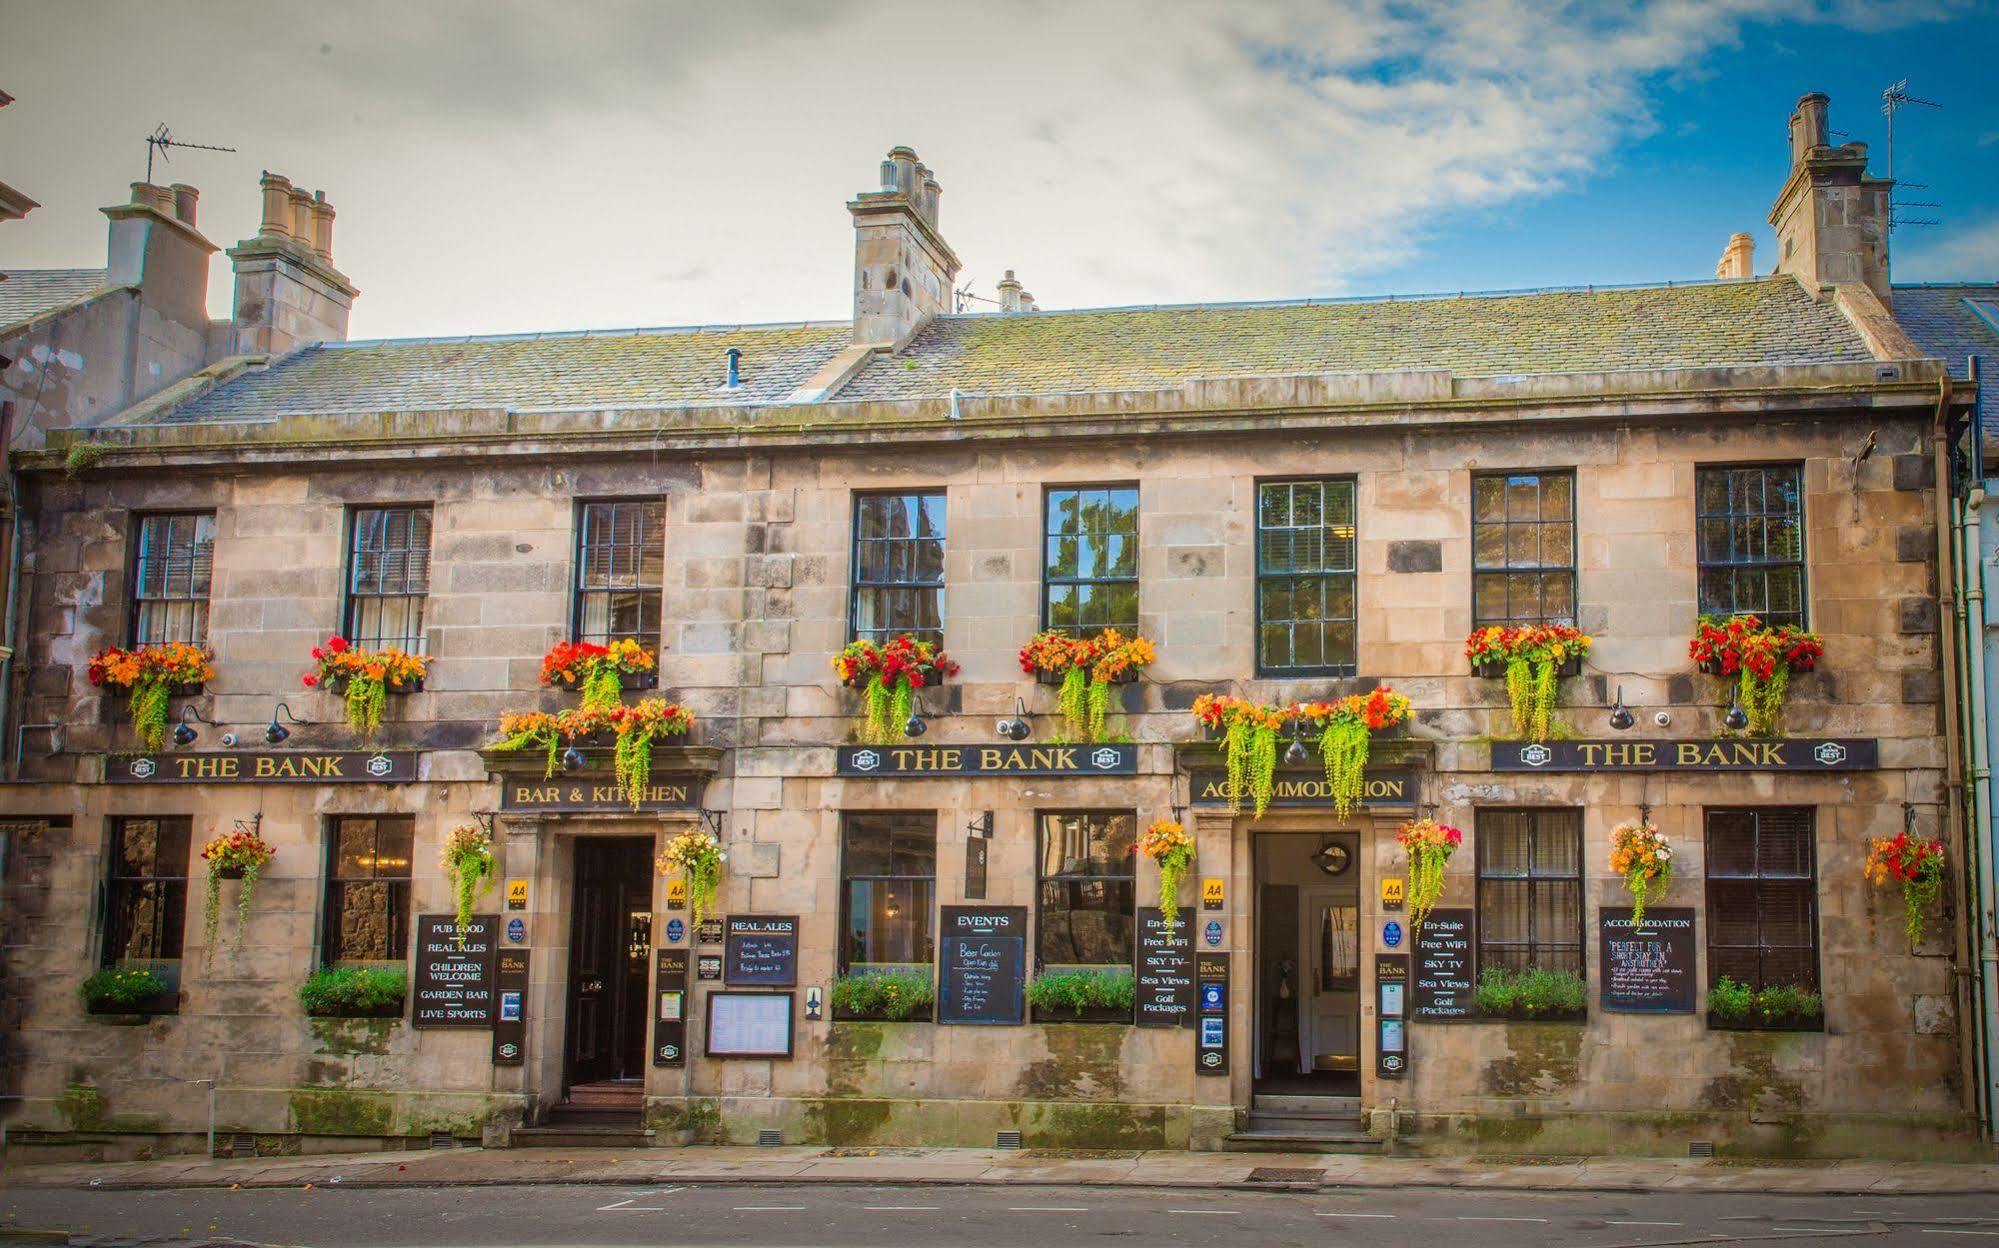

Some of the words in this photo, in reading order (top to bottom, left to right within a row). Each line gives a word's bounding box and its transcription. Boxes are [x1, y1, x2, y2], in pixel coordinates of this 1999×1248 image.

[891, 749, 962, 770] THE
[980, 748, 1078, 770] BANK
[1577, 744, 1657, 766] THE
[1676, 743, 1786, 765] BANK
[176, 757, 240, 777] THE
[255, 756, 343, 777] BANK
[1201, 780, 1403, 798] ACCMMODION
[515, 787, 561, 803] BAR
[569, 787, 584, 803] &
[512, 886, 525, 896] AA
[1207, 885, 1221, 895] AA
[1385, 885, 1400, 896] AA
[958, 916, 1009, 926] EVENTS
[1147, 919, 1185, 928] En-Site
[1423, 921, 1464, 930] En-Suite
[1604, 919, 1690, 928] ACCOMMODATION
[433, 924, 453, 933] PUB
[731, 922, 760, 931] REAL
[764, 922, 792, 931] ALES
[1144, 938, 1164, 946] Free
[1421, 940, 1442, 949] Free
[428, 944, 456, 952] REAL
[460, 944, 487, 952] ALES
[1647, 941, 1662, 952] FOR
[1666, 941, 1672, 953] A
[1147, 957, 1167, 965] SKY
[1169, 957, 1185, 965] TV
[1424, 960, 1445, 968] SKY
[1448, 960, 1464, 968] TV
[430, 963, 482, 972] CHILDREN
[430, 972, 481, 980] WELCOME
[1141, 976, 1158, 984] Sea
[1161, 976, 1190, 984] Views
[1418, 979, 1436, 988] Sea
[1440, 980, 1469, 988] Views
[421, 991, 463, 999] GARDEN
[466, 991, 488, 999] BAR
[1155, 994, 1175, 1003] Golf
[1433, 997, 1454, 1006] Golf
[1144, 1003, 1187, 1013] Packages
[1422, 1007, 1465, 1015] Packages
[421, 1010, 444, 1018] LIVE
[447, 1010, 487, 1018] SPORTS
